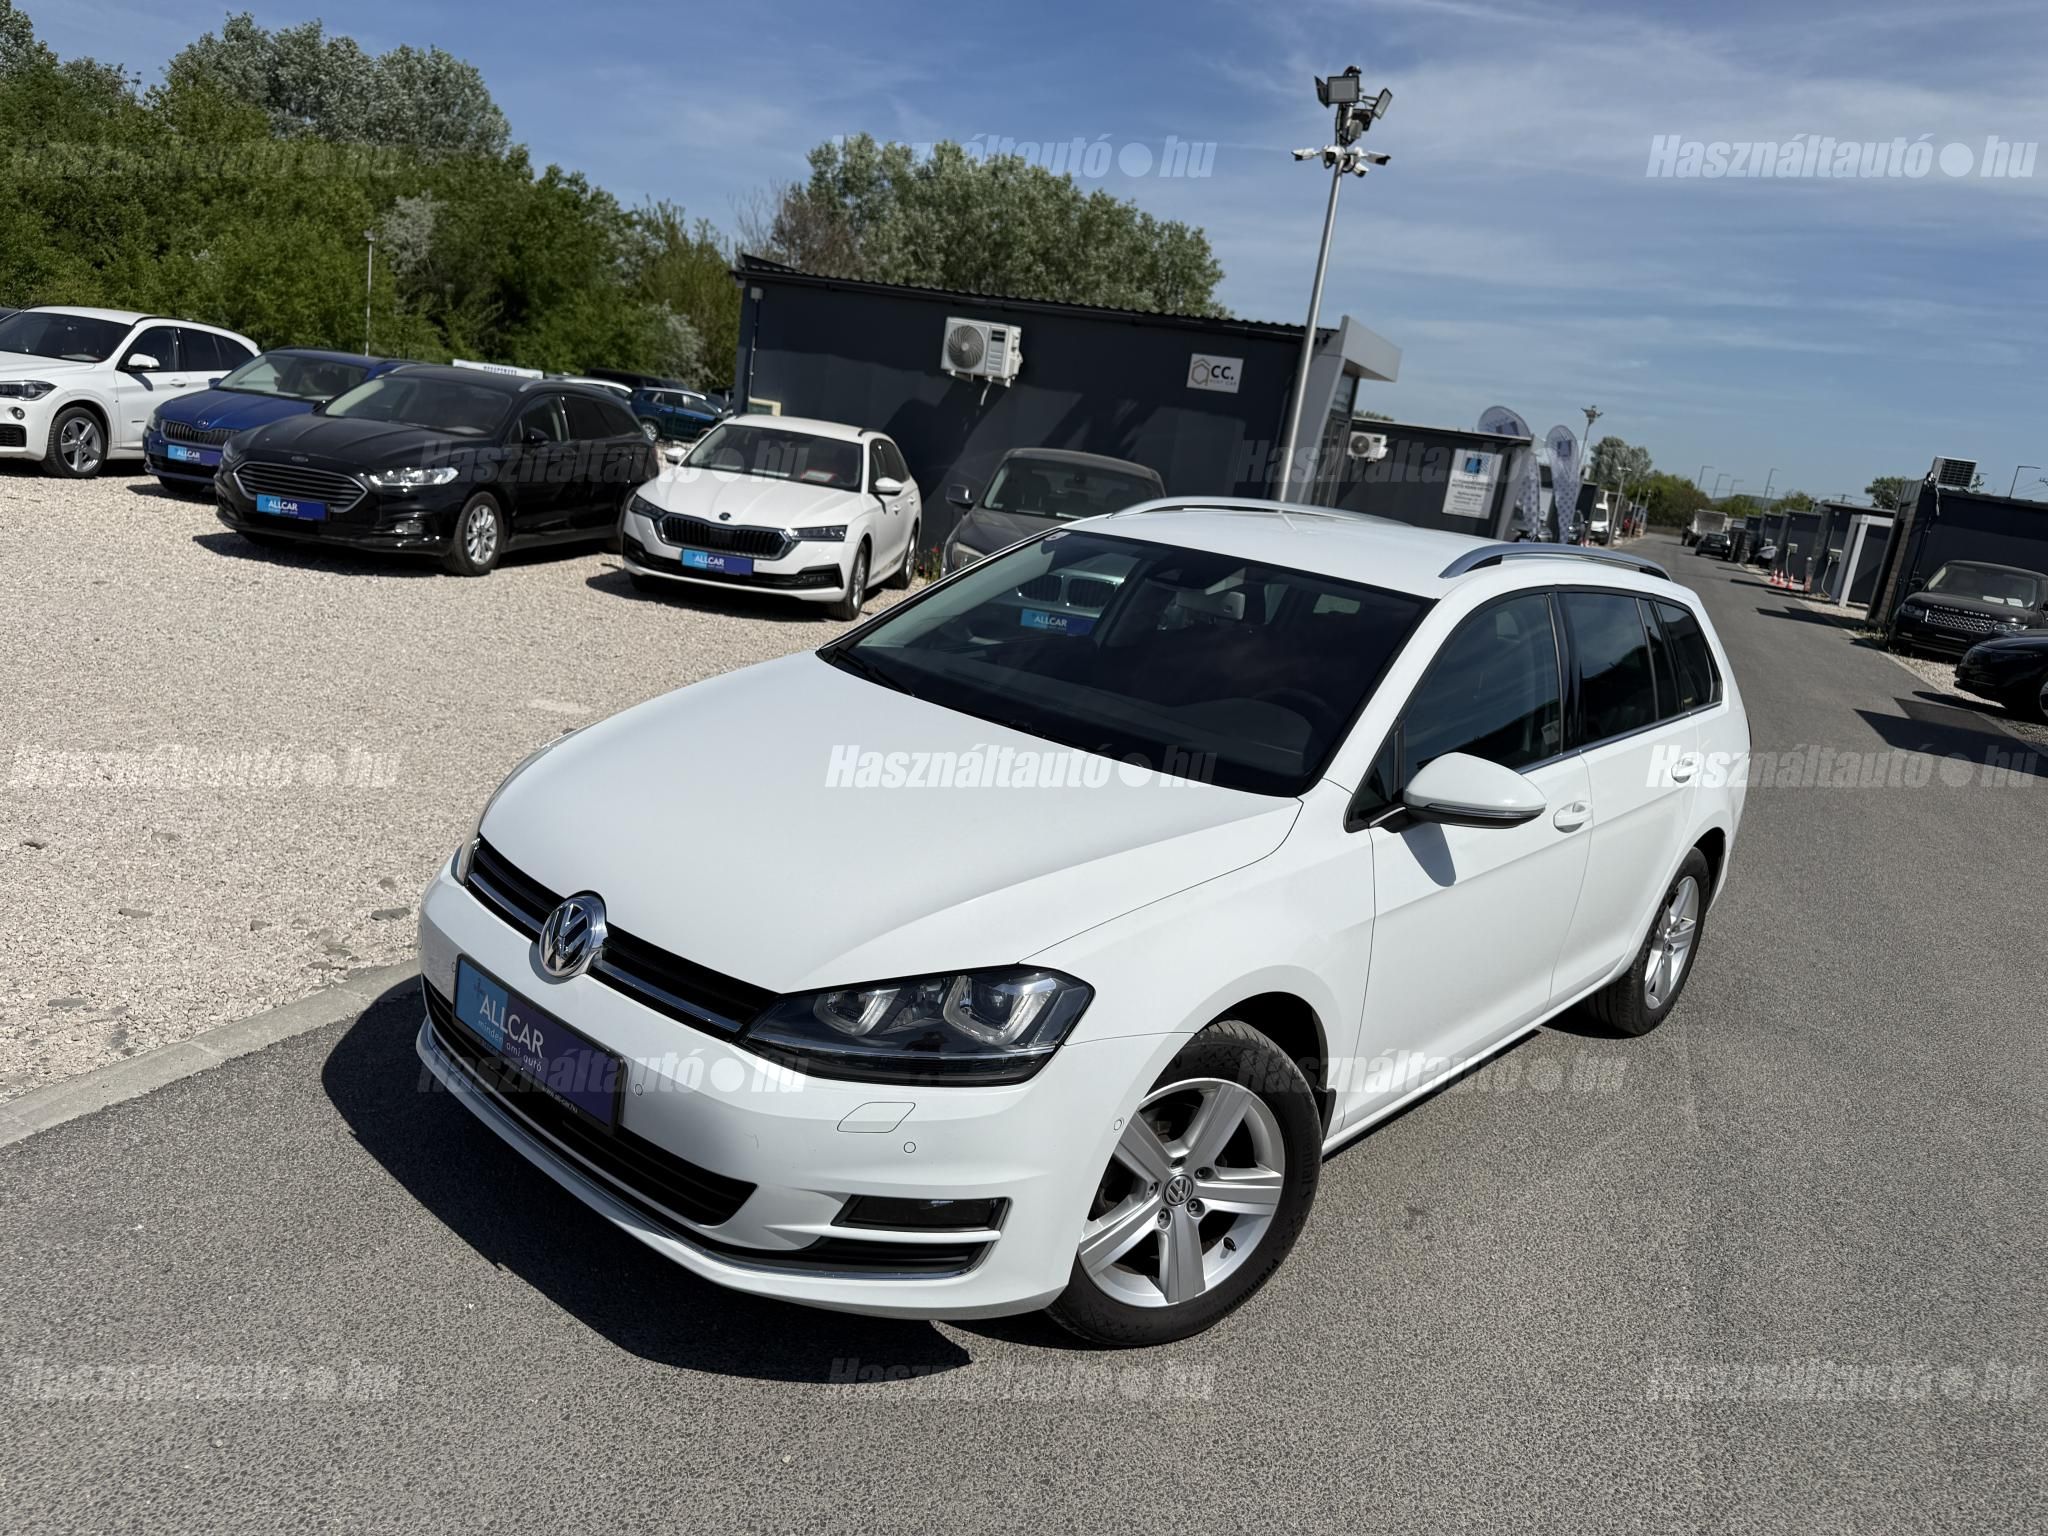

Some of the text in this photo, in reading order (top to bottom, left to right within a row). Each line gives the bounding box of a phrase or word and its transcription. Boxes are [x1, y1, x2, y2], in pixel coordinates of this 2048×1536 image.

[177, 449, 200, 459] ALLCAR
[268, 500, 298, 511] ALLCAR
[694, 555, 725, 566] ALLCAR
[1033, 615, 1068, 627] ALLCAR
[480, 994, 544, 1058] ALLCAR
[478, 1020, 542, 1072] minden ami autó
